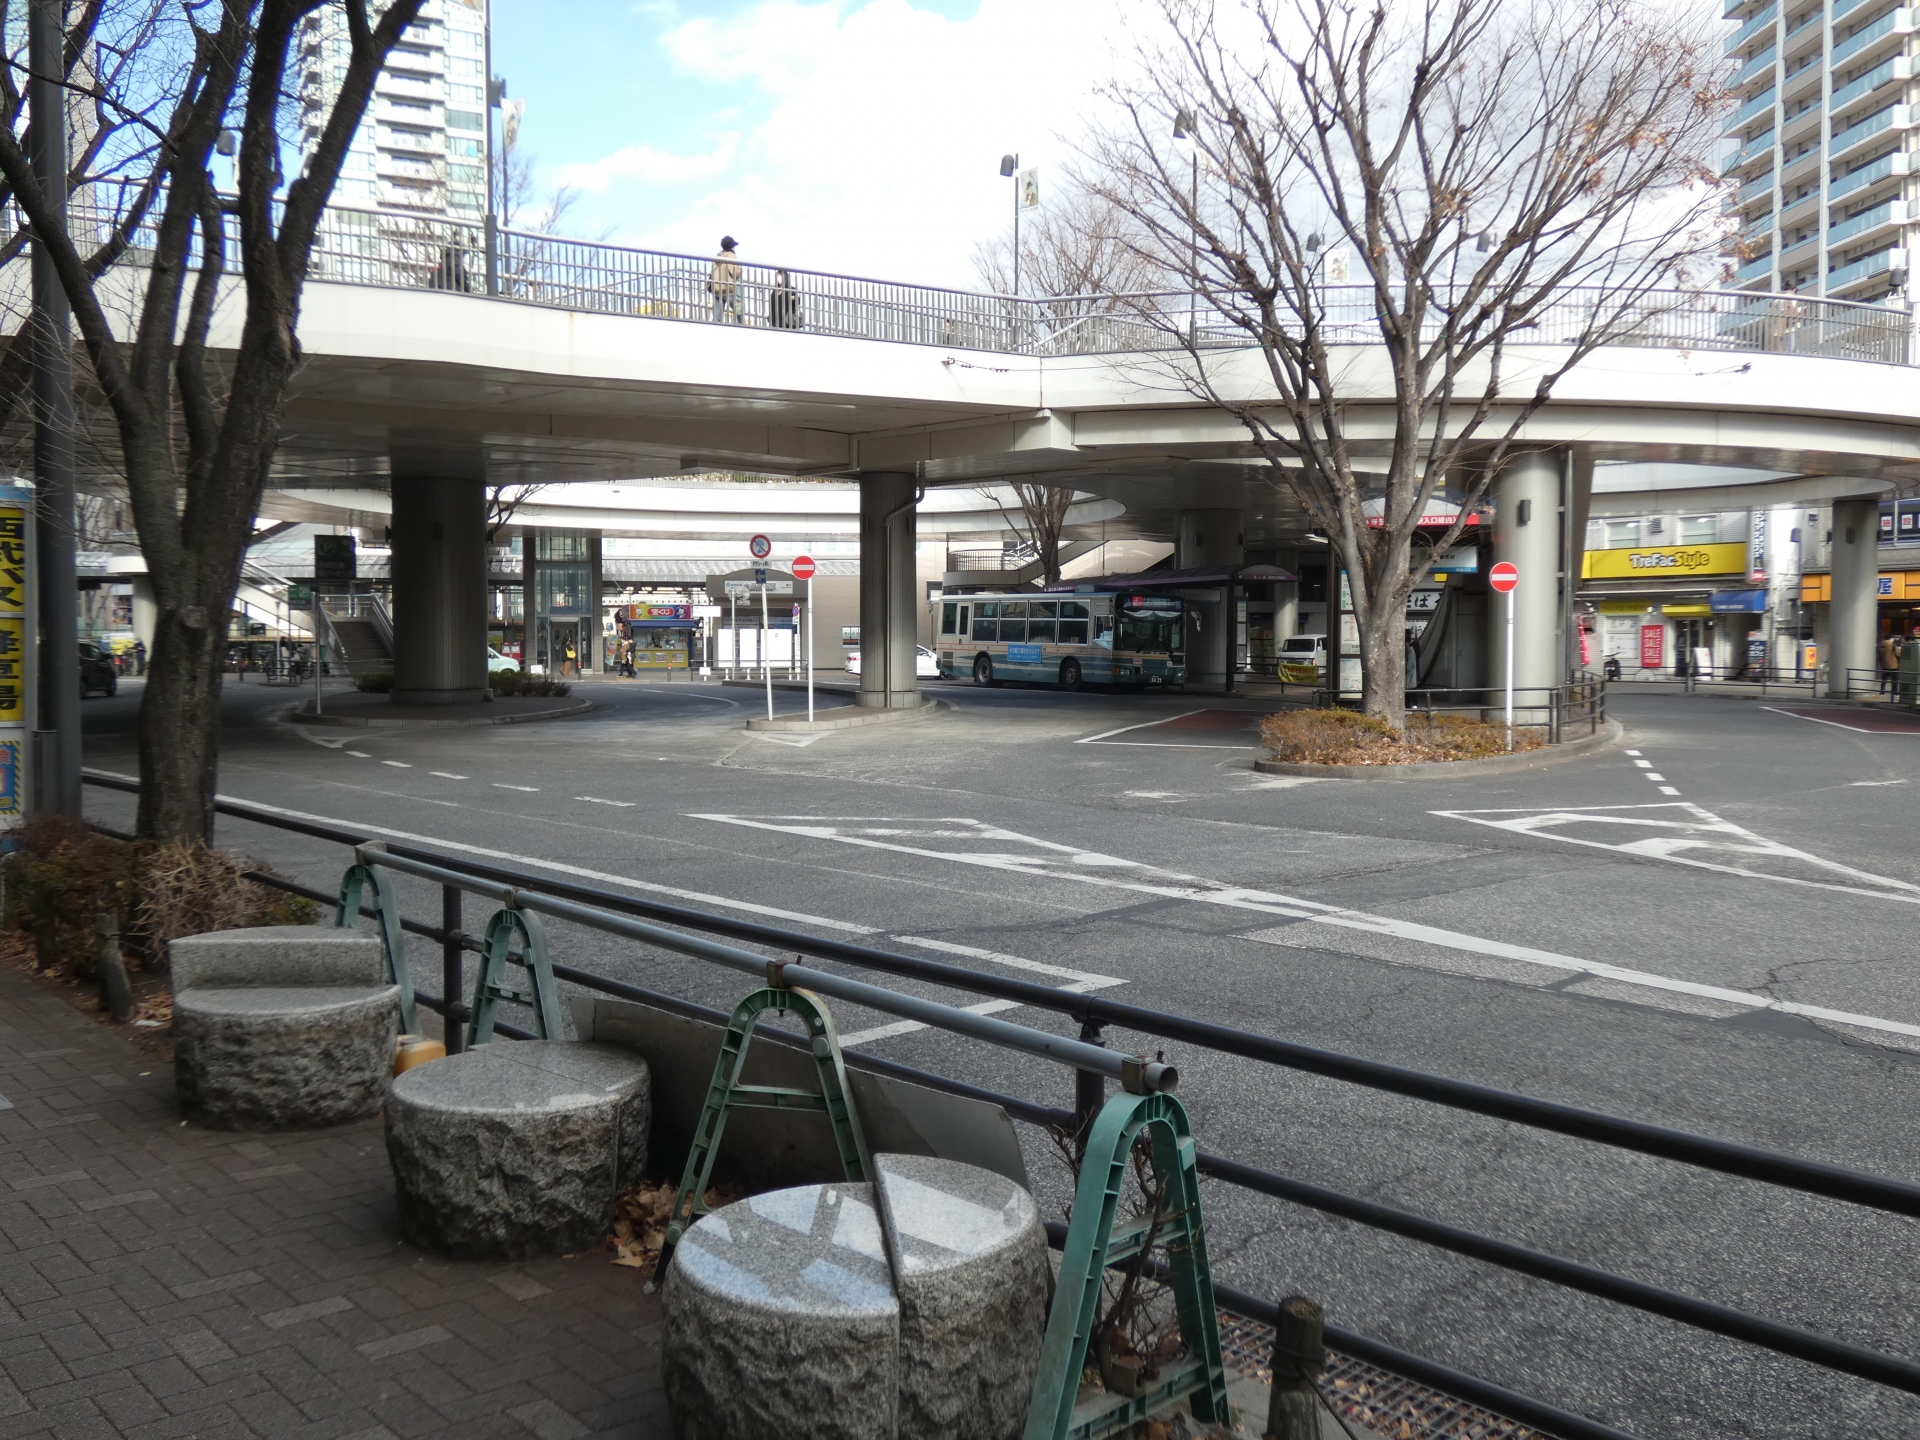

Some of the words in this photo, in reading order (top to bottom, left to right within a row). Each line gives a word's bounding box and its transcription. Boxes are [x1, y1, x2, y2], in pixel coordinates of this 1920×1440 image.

[651, 608, 671, 616] 宝くじ
[1644, 629, 1662, 638] SALE
[1644, 638, 1661, 648] SALE
[1644, 647, 1660, 657] SALE
